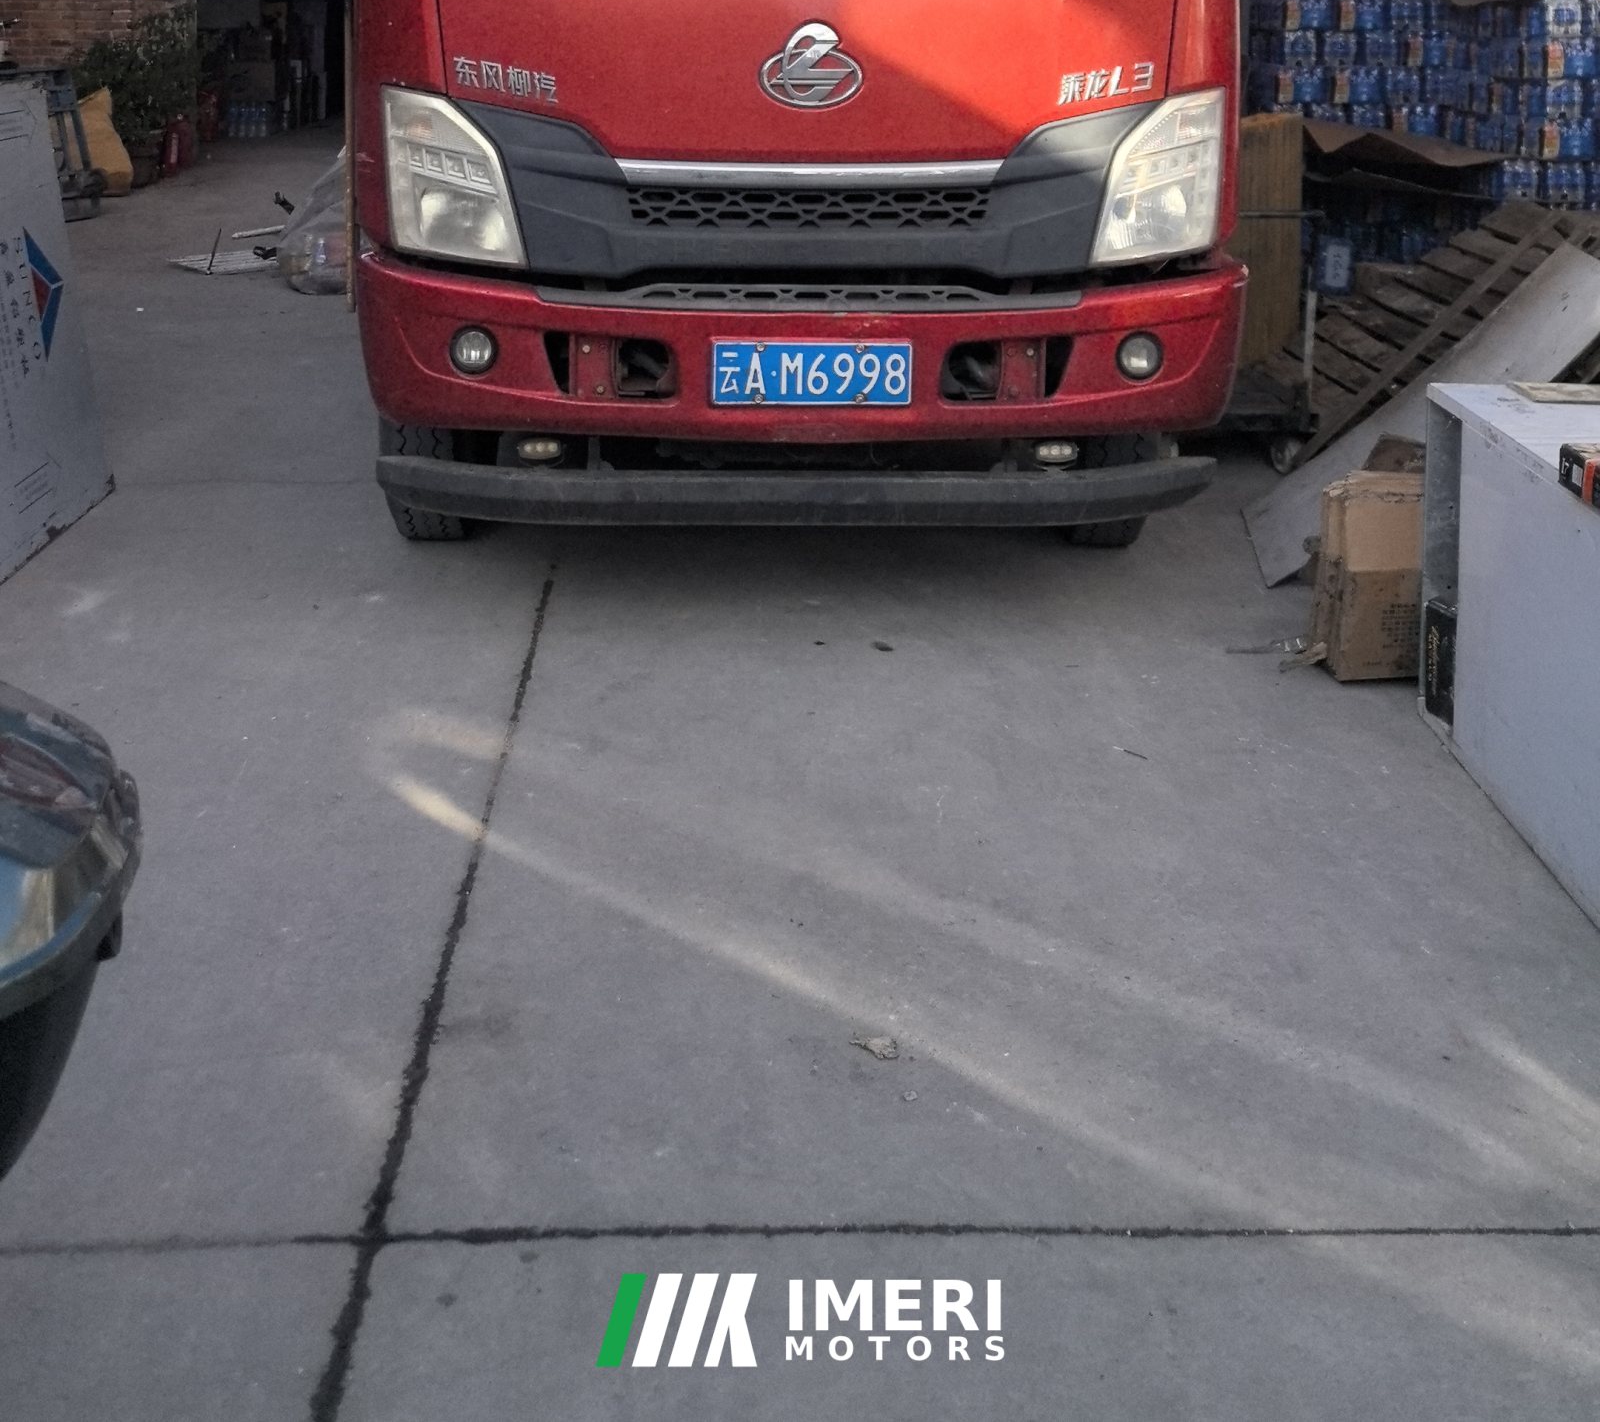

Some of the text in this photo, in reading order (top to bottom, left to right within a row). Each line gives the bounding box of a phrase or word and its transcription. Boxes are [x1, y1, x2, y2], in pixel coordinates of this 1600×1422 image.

[453, 56, 559, 103] 东风柳汽
[719, 352, 906, 395] 云A·M6998
